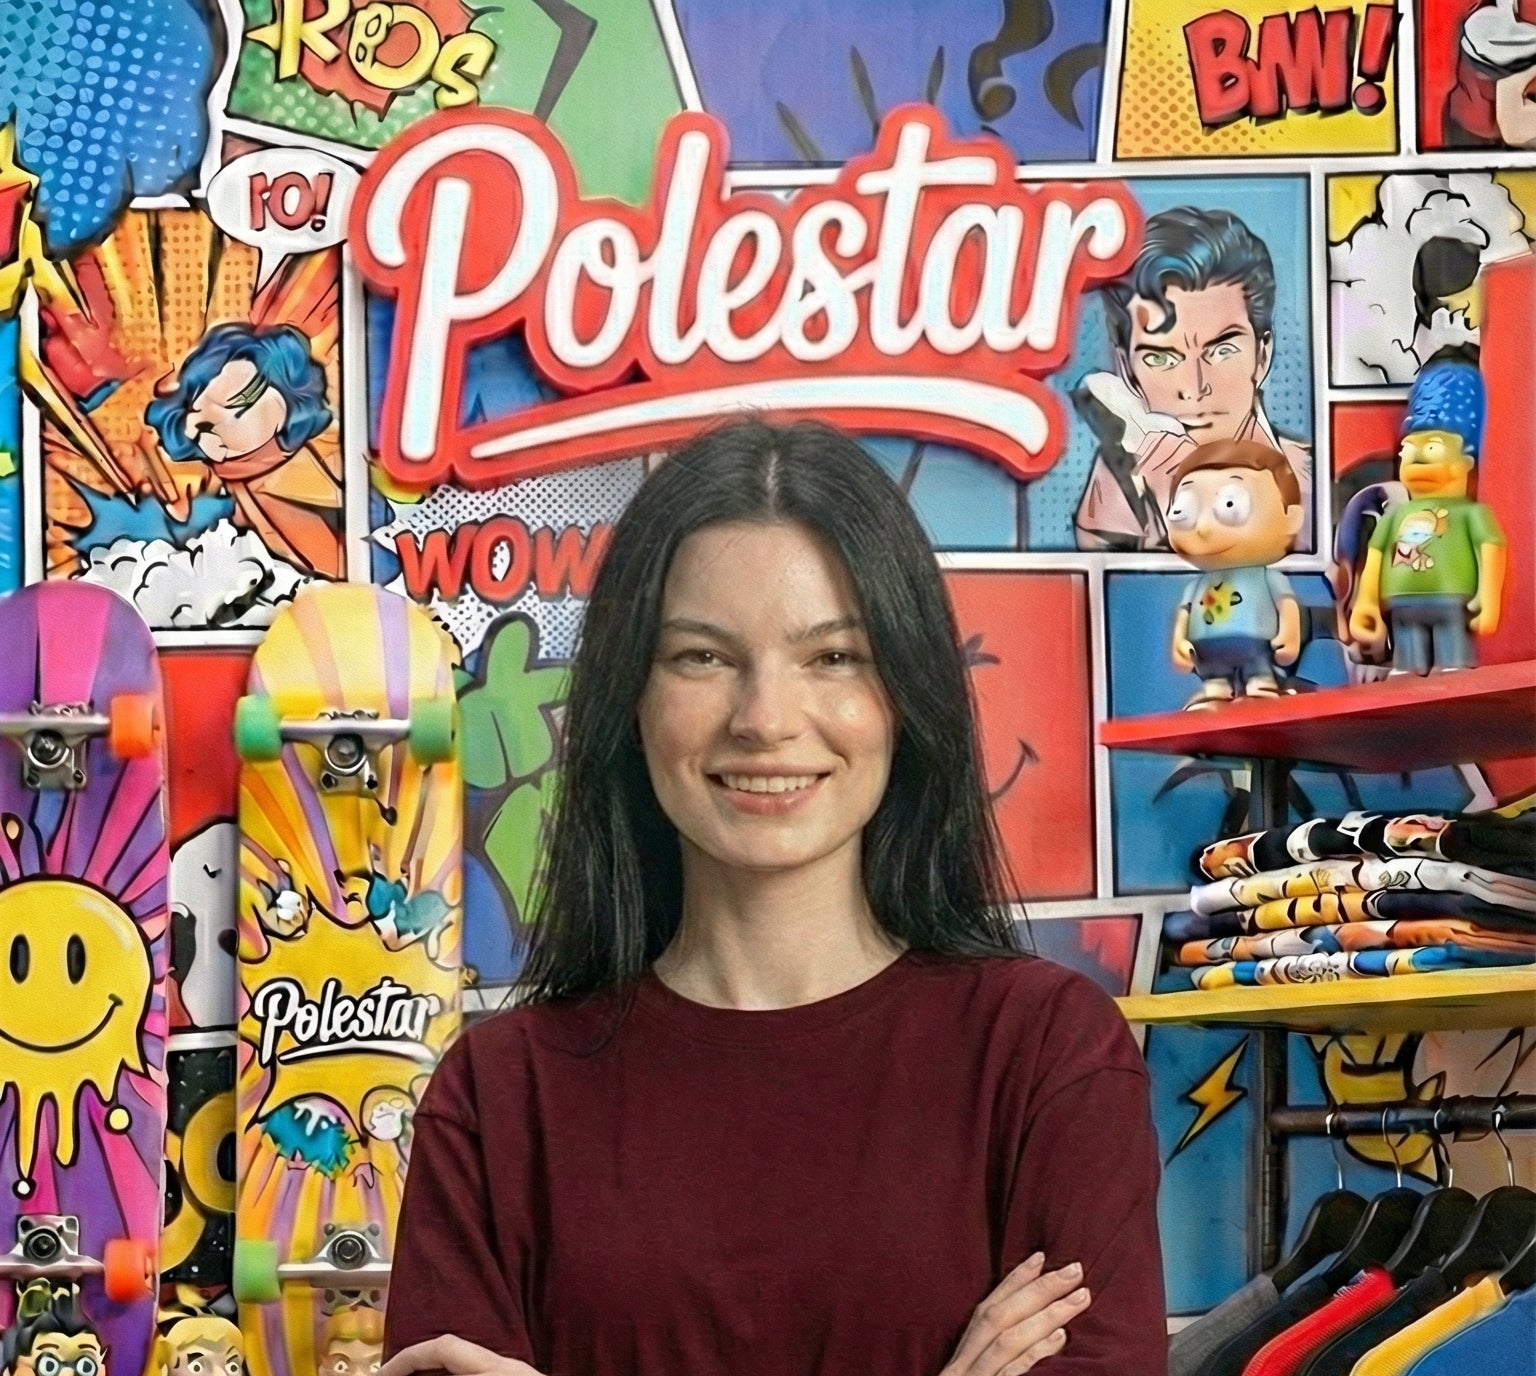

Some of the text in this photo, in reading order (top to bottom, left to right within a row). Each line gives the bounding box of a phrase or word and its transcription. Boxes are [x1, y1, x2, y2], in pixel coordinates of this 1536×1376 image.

[366, 121, 1127, 463] Polestar
[393, 513, 616, 604] WOW
[253, 978, 442, 1066] Polestar
